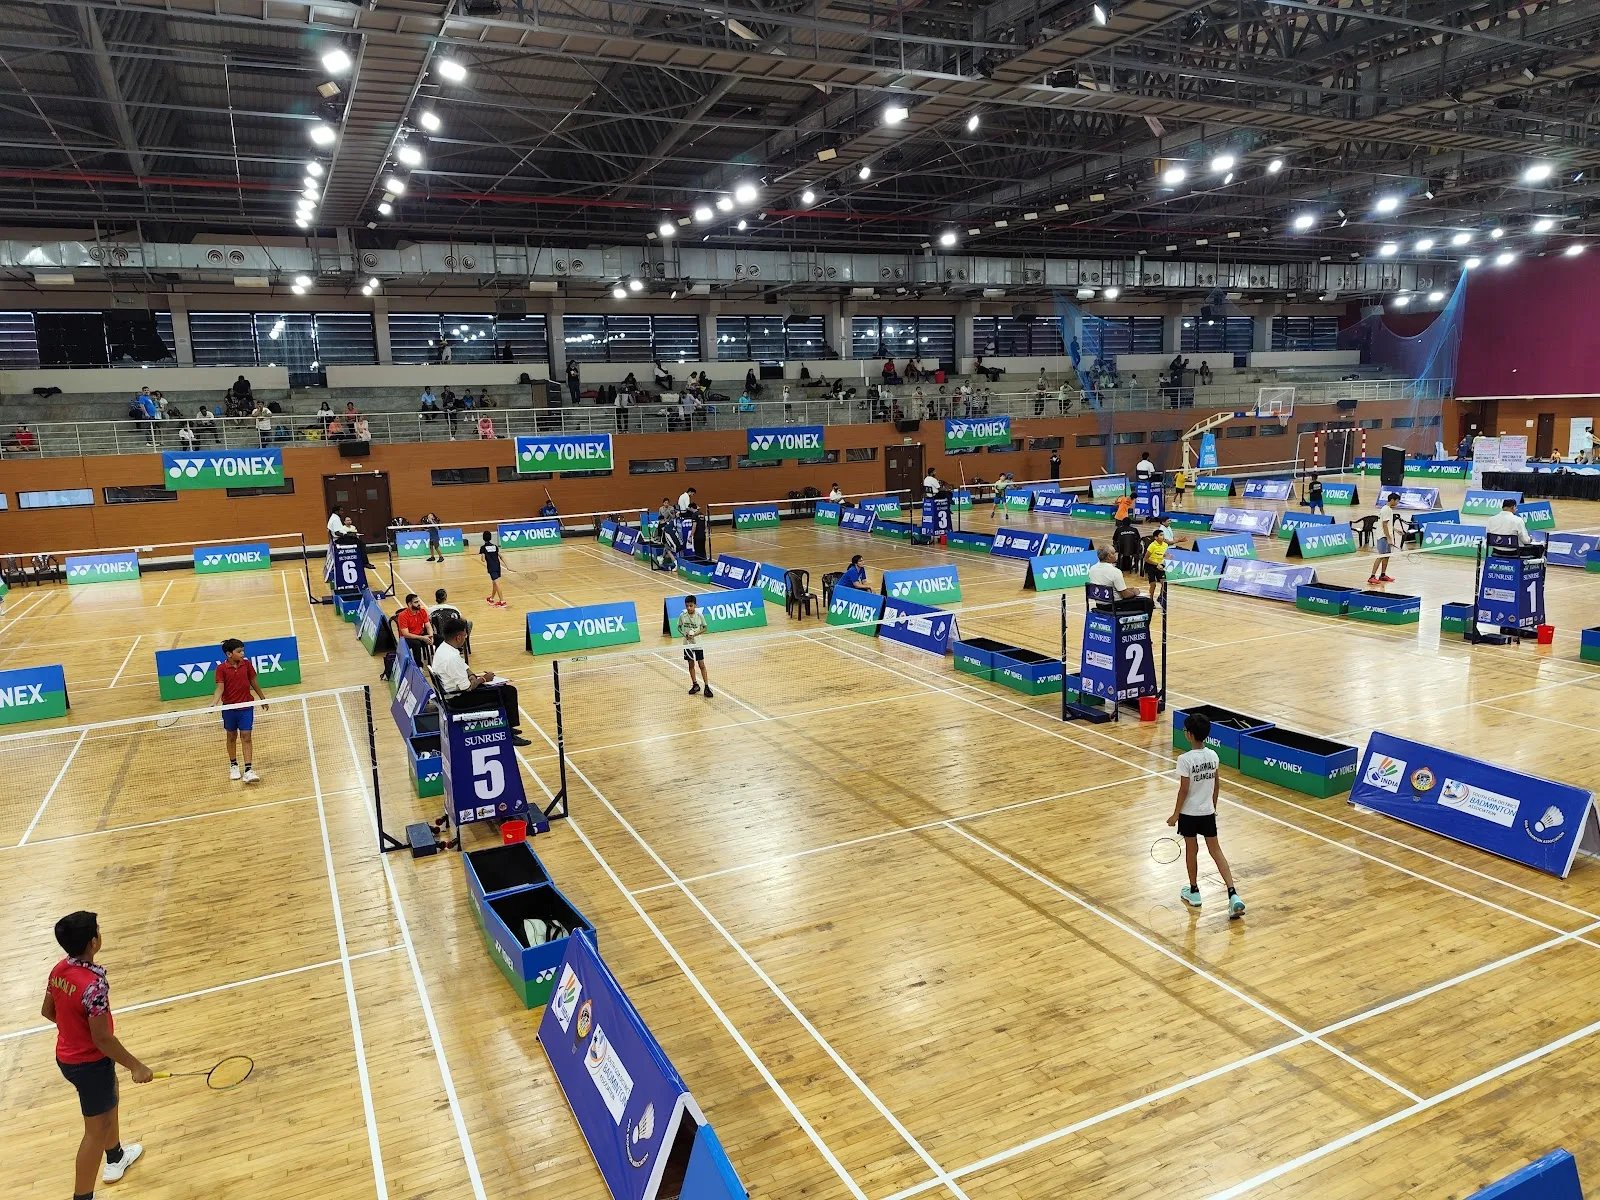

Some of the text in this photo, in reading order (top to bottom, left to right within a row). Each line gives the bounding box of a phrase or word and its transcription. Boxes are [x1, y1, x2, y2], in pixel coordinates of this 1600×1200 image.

[971, 422, 1006, 437] YONEX
[778, 434, 819, 450] YONEX
[554, 443, 605, 460] YONEX
[210, 457, 276, 476] YONEX
[1107, 483, 1126, 492] YONEX
[1208, 483, 1228, 492] YONEX
[1326, 490, 1349, 499] YONEX
[876, 502, 898, 512] YONEX
[1012, 496, 1029, 506] YONEX
[1152, 495, 1160, 518] 9
[1485, 497, 1503, 508] YON
[752, 512, 776, 521] YONEX
[825, 510, 836, 519] YONEX
[938, 510, 948, 528] 3
[1530, 510, 1551, 522] YONEX
[522, 528, 558, 540] YONEX
[424, 537, 456, 548] YNEX
[1321, 534, 1348, 548] YONEX
[1450, 535, 1486, 548] YONEX
[1222, 544, 1250, 556] YONEX
[226, 552, 261, 564] YONEX
[94, 562, 134, 574] YONEX
[342, 561, 358, 584] 6
[1181, 561, 1216, 576] YONEX
[915, 576, 954, 592] YONEX
[1104, 590, 1110, 598] 2
[1526, 580, 1536, 613] 1
[708, 602, 756, 620] YONEX
[847, 602, 877, 622] YONEX
[574, 616, 626, 636] YONEX
[1089, 633, 1112, 644] SUNRISE
[1122, 633, 1146, 643] SUNRISE
[1126, 644, 1145, 684] 2
[480, 718, 504, 729] YONEX
[464, 732, 506, 746] SUNRISE
[1203, 736, 1222, 748] ONEX
[472, 746, 506, 800] 5
[1278, 760, 1302, 774] YONEX
[1340, 764, 1356, 776] YONEX
[1380, 778, 1398, 788] INDIA
[1472, 792, 1486, 800] SOUTH
[1468, 804, 1497, 816] ASSOCIATION
[1469, 797, 1516, 817] BADMINTON
[1542, 832, 1565, 844] ASSOCIATION
